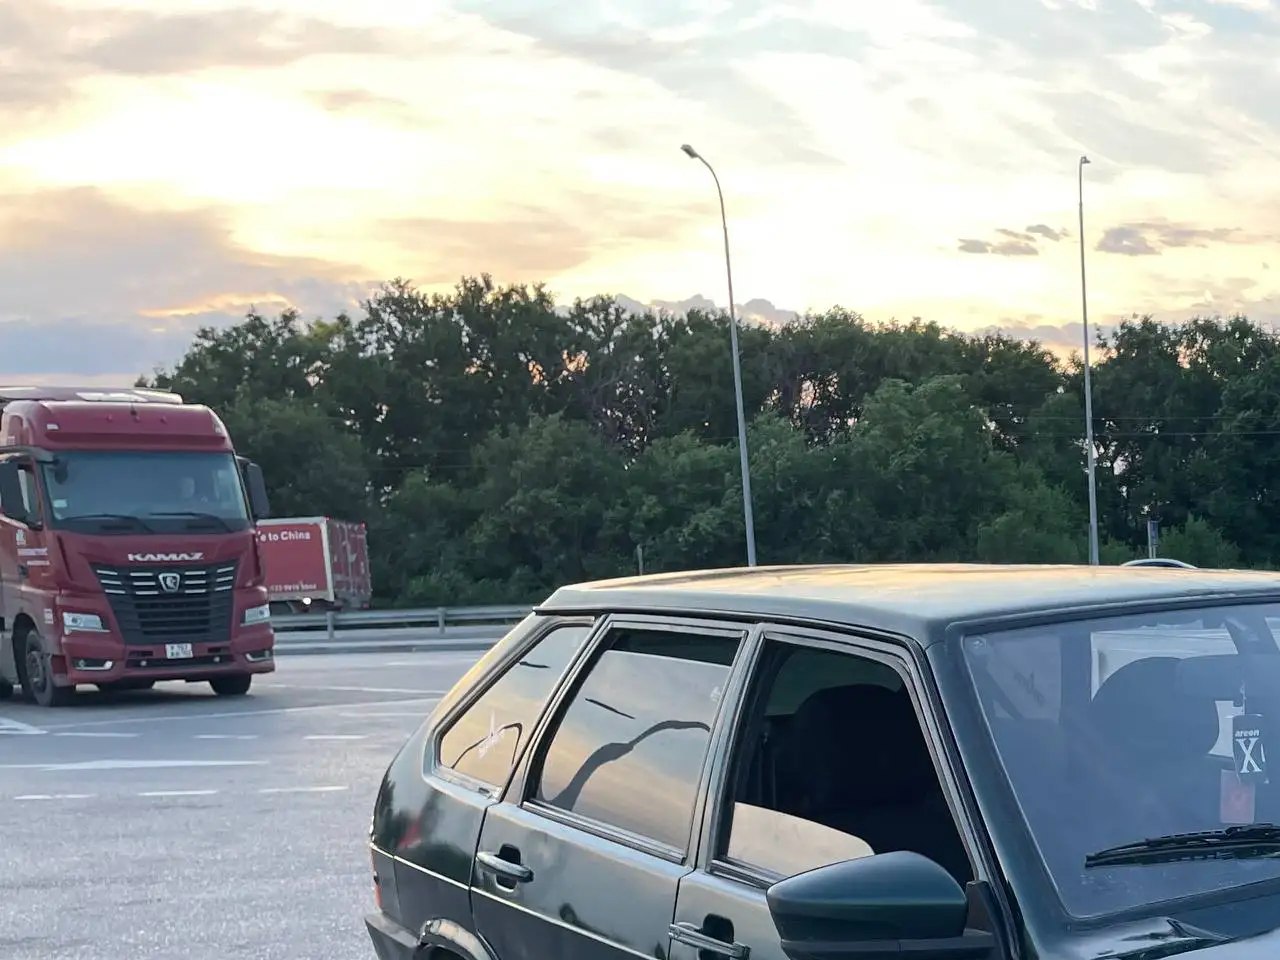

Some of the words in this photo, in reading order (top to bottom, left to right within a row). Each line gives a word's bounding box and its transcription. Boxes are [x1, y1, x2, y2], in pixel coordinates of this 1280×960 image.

[268, 532, 278, 541] to
[281, 531, 310, 541] China
[128, 553, 204, 561] KAMAZ
[1236, 738, 1262, 773] X
